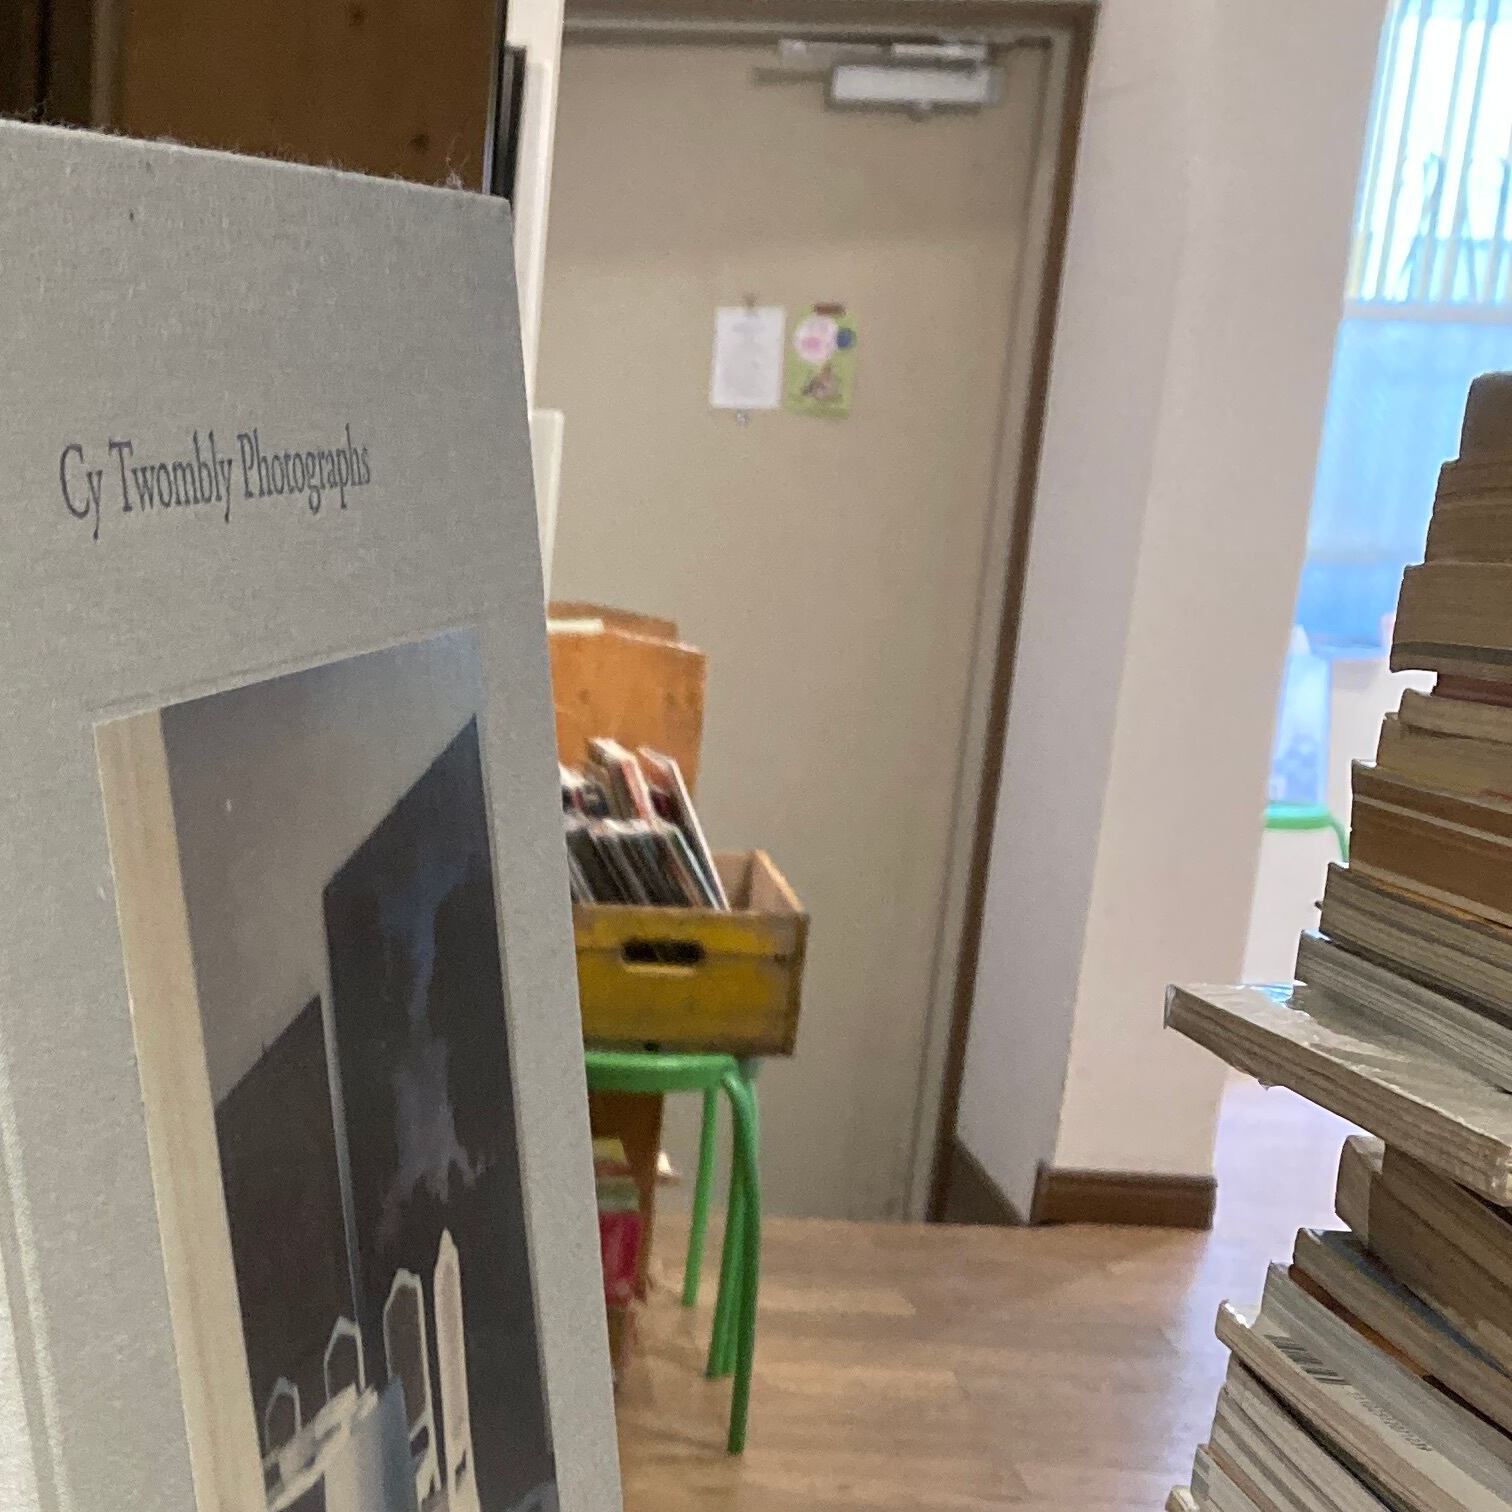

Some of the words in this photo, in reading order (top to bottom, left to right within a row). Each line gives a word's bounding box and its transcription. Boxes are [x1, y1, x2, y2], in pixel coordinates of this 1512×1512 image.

[59, 442, 104, 541] Cy
[108, 429, 234, 524] Twombly
[237, 422, 372, 516] Photographs
